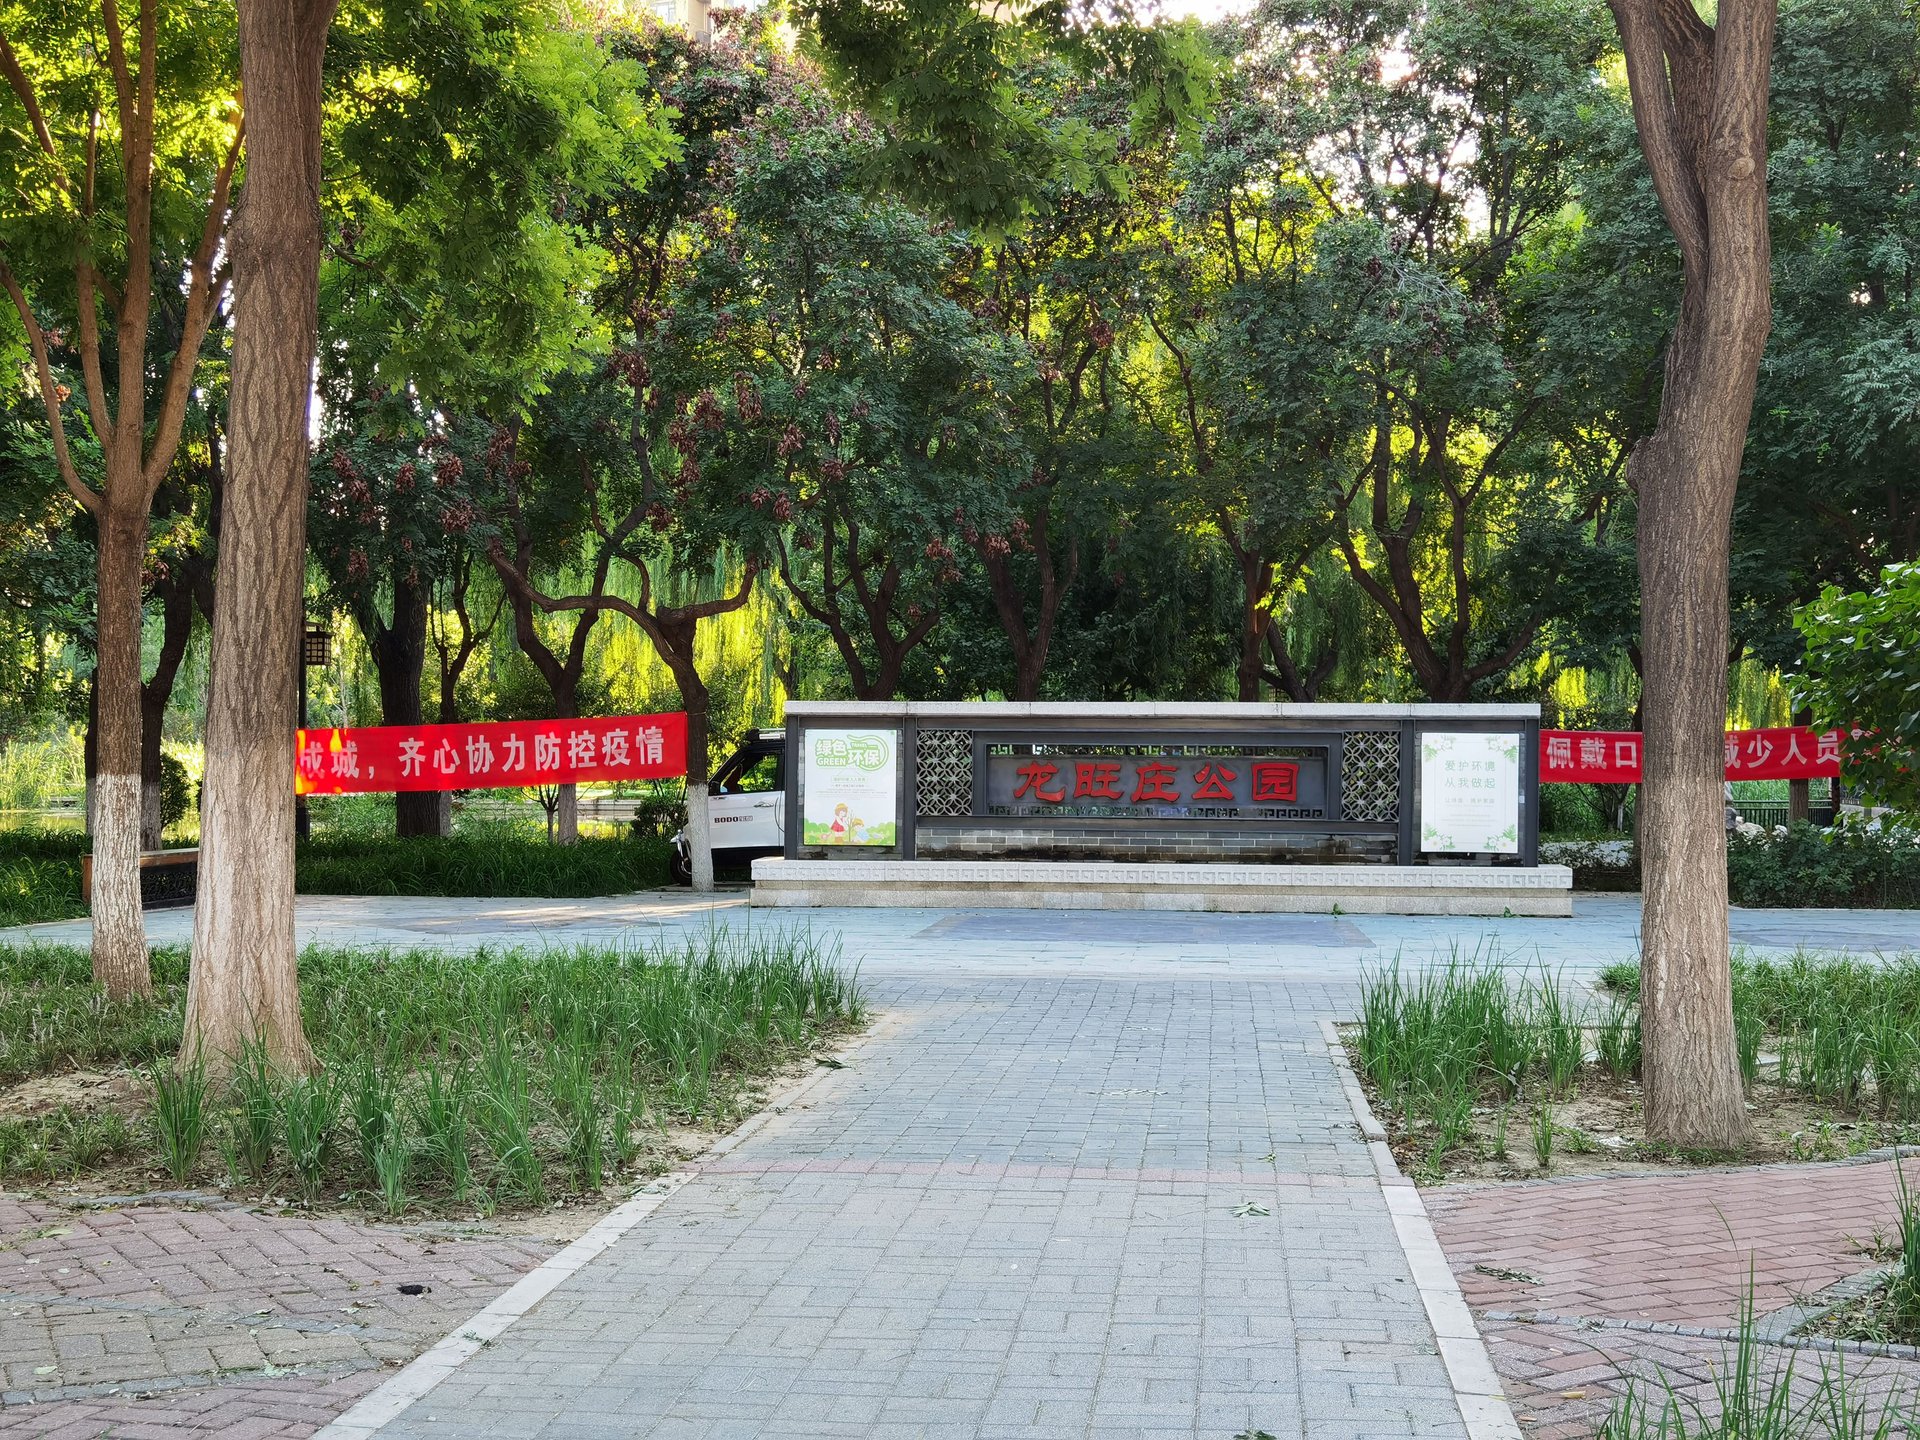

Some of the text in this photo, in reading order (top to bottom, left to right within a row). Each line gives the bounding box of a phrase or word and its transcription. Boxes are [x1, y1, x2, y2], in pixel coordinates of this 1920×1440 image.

[816, 740, 846, 756] 绿色
[1546, 737, 1638, 769] 佩戴口
[817, 757, 847, 766] GREEN
[847, 749, 880, 766] 环保
[1444, 760, 1495, 771] 爱护环境
[1013, 760, 1300, 803] 龙旺庄公园
[1444, 777, 1495, 788] 从我做起
